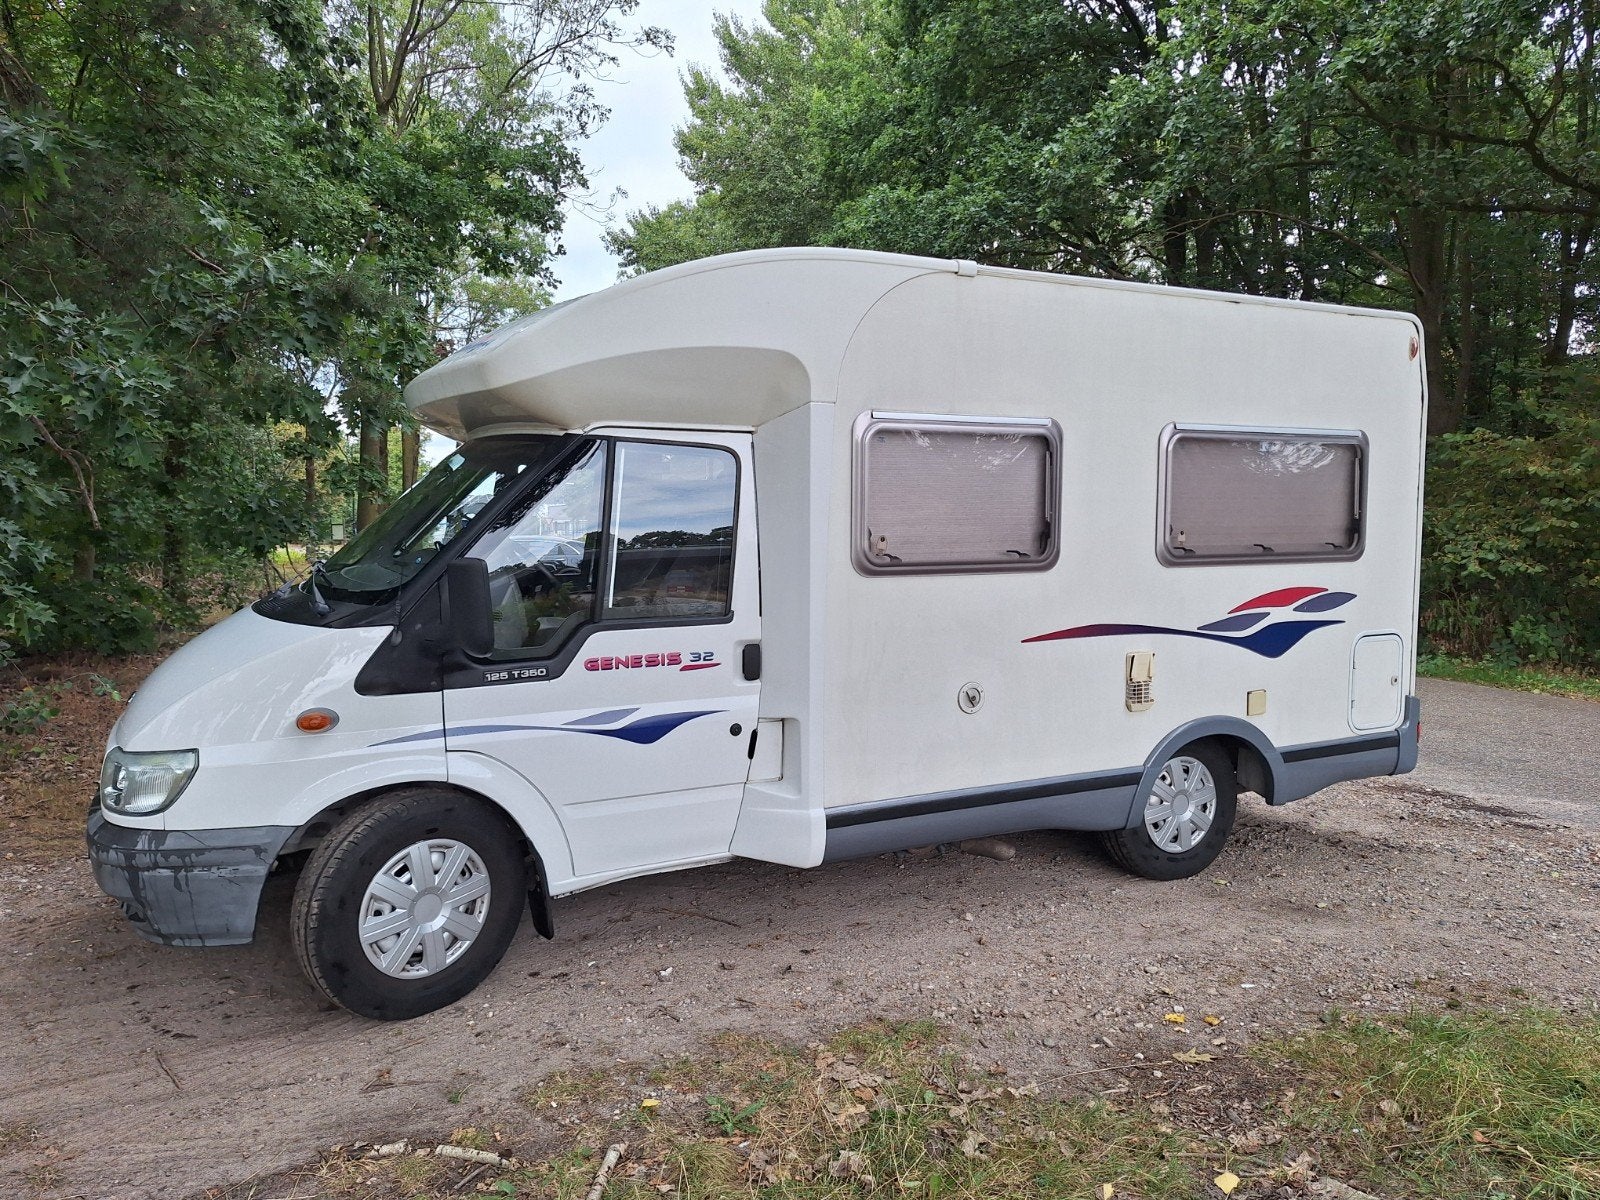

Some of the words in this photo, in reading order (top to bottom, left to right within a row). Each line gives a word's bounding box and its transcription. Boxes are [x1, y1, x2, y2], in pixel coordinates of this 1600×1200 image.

[583, 652, 683, 672] GENESIS
[689, 651, 715, 663] 32
[485, 671, 509, 681] 125
[511, 668, 547, 679] T350
